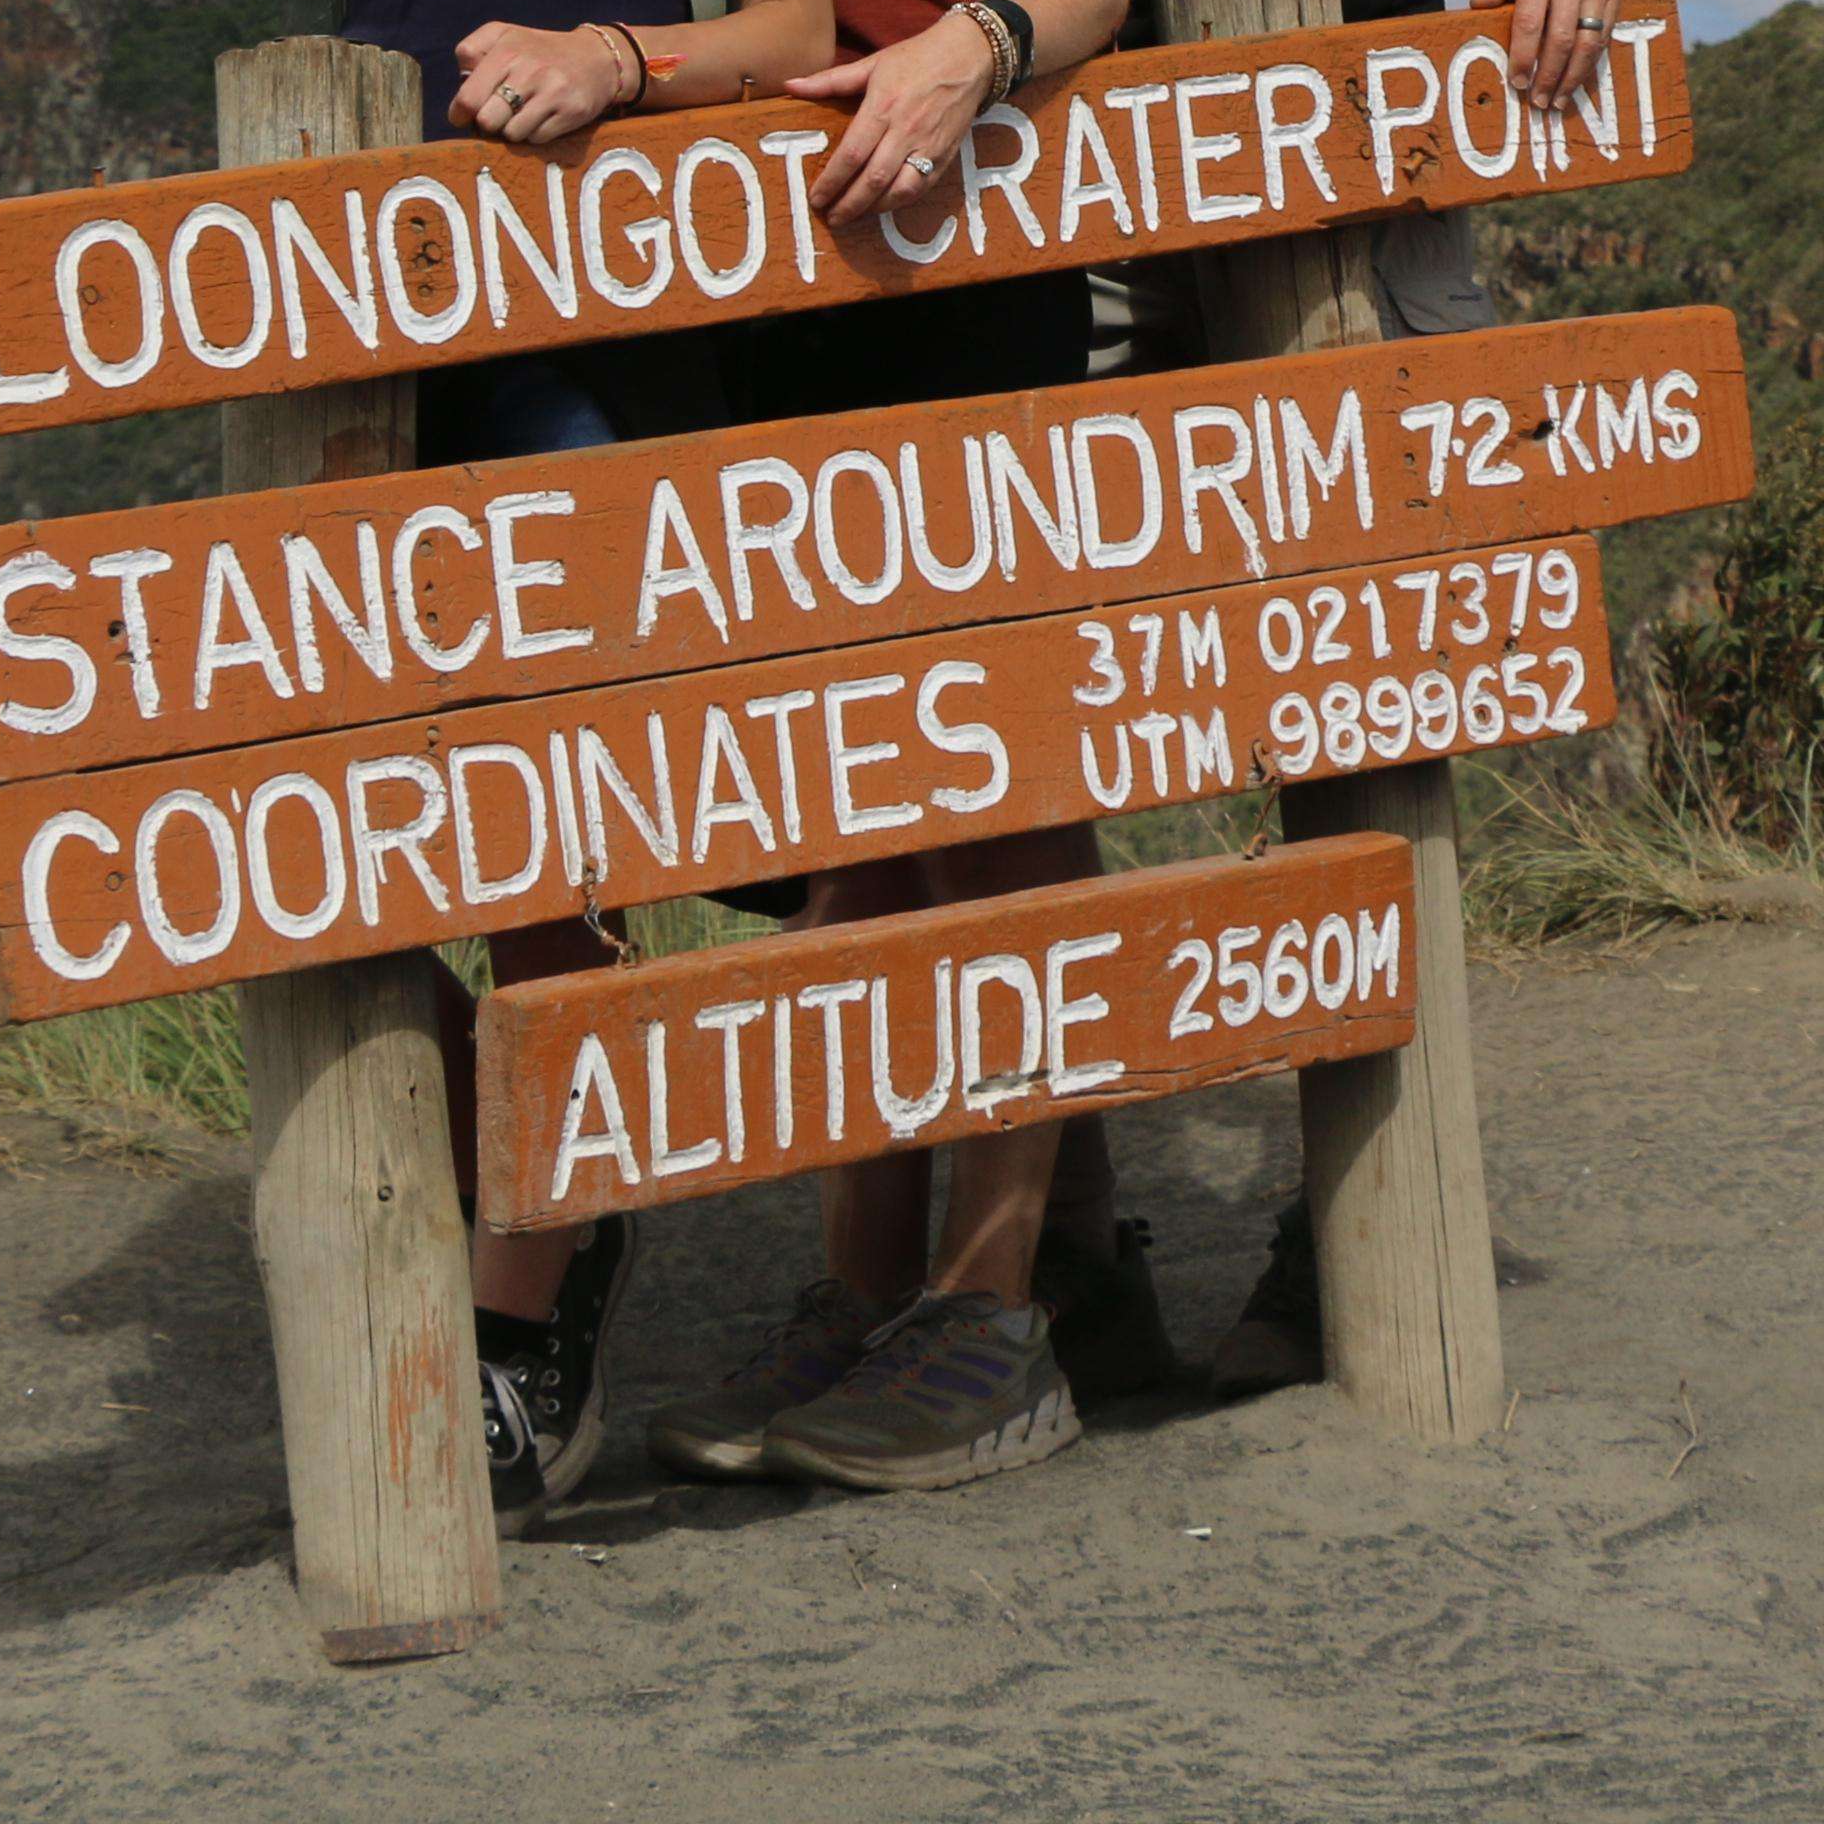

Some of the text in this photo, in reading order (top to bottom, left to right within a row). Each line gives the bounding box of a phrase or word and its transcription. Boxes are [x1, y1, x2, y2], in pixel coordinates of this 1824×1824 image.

[635, 412, 1165, 645] AROUND
[1172, 387, 1375, 581] RIM
[1542, 368, 1702, 478] KMS
[1071, 605, 1228, 708] 37M
[1256, 548, 1580, 675] 0217379
[1079, 645, 1589, 810] UTM 9899652
[549, 901, 1402, 1202] ALTITUDE 2560M
